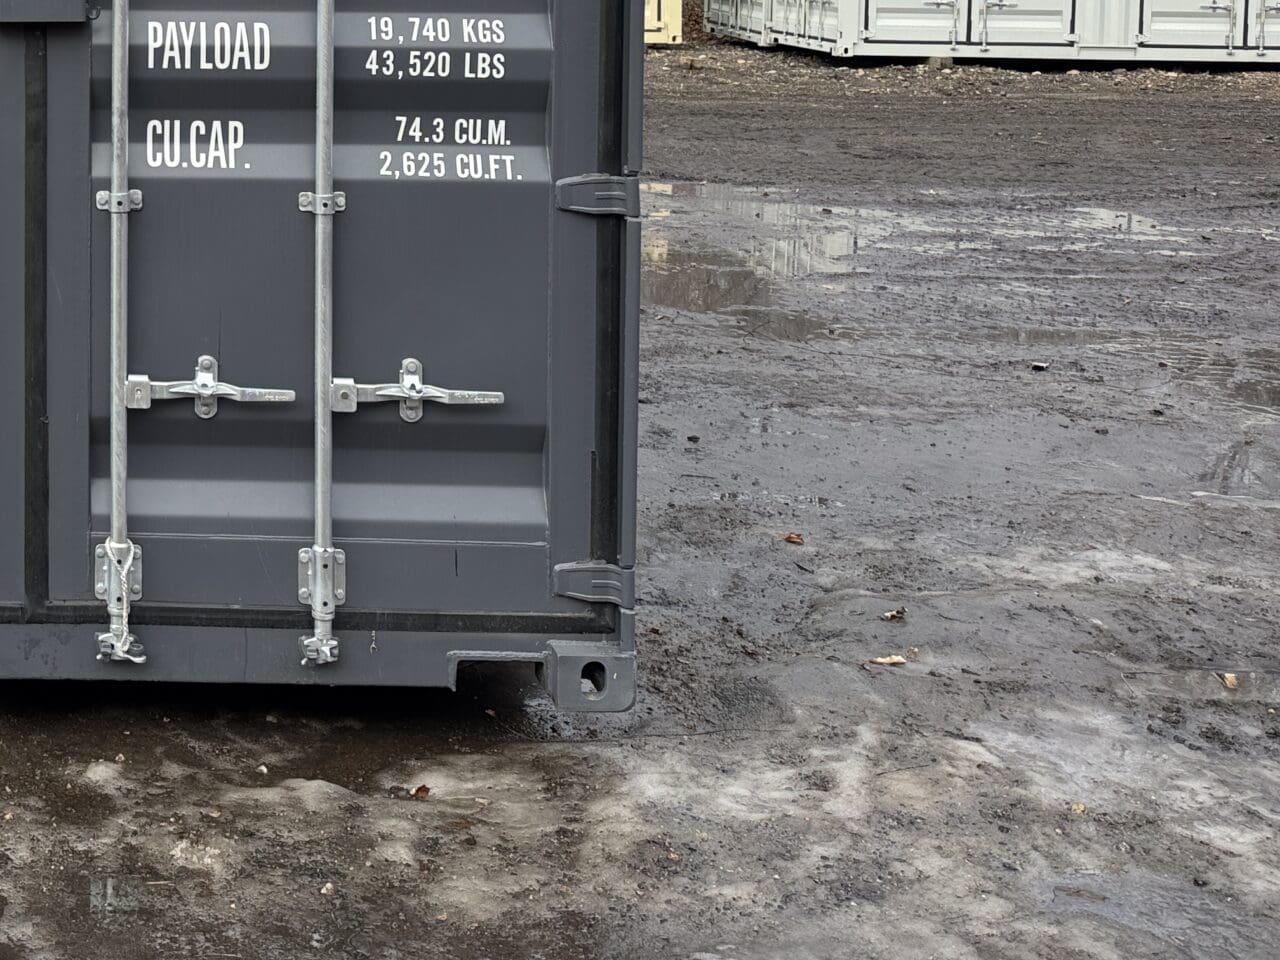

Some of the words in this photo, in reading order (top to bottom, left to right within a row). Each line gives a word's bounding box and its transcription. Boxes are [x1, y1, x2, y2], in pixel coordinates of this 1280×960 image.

[147, 21, 271, 70] PAYLOAD
[367, 16, 451, 45] 19,740
[462, 18, 505, 44] KGS
[365, 50, 451, 80] 43,520
[464, 52, 505, 78] LBS
[146, 119, 251, 169] CU.CAP.
[395, 116, 444, 142] 74.3
[454, 118, 511, 145] CU.M.
[379, 151, 446, 179] 2,625
[455, 153, 523, 181] CU.FT.
